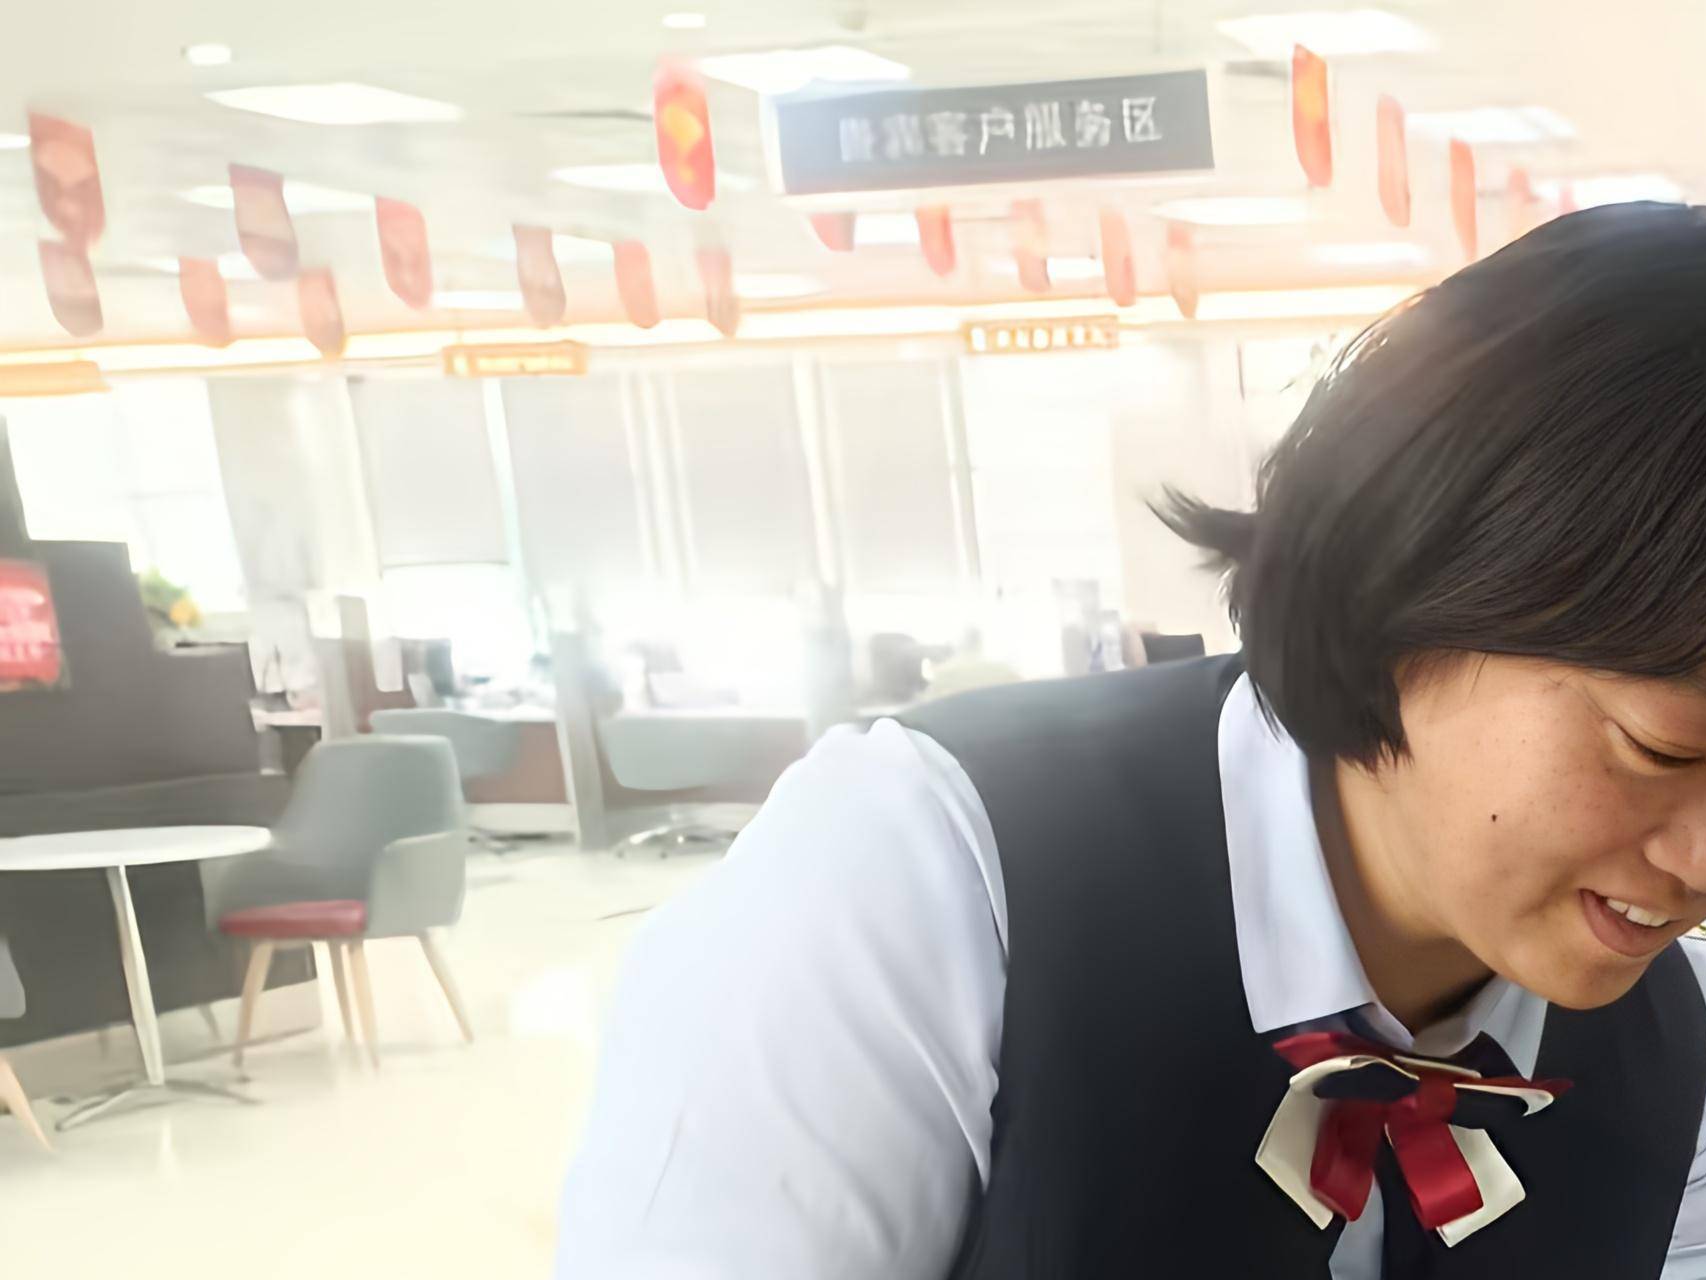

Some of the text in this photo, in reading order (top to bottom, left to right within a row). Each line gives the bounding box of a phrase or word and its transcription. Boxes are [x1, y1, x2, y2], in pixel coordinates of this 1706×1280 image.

[838, 96, 1163, 163] 客户服务区
